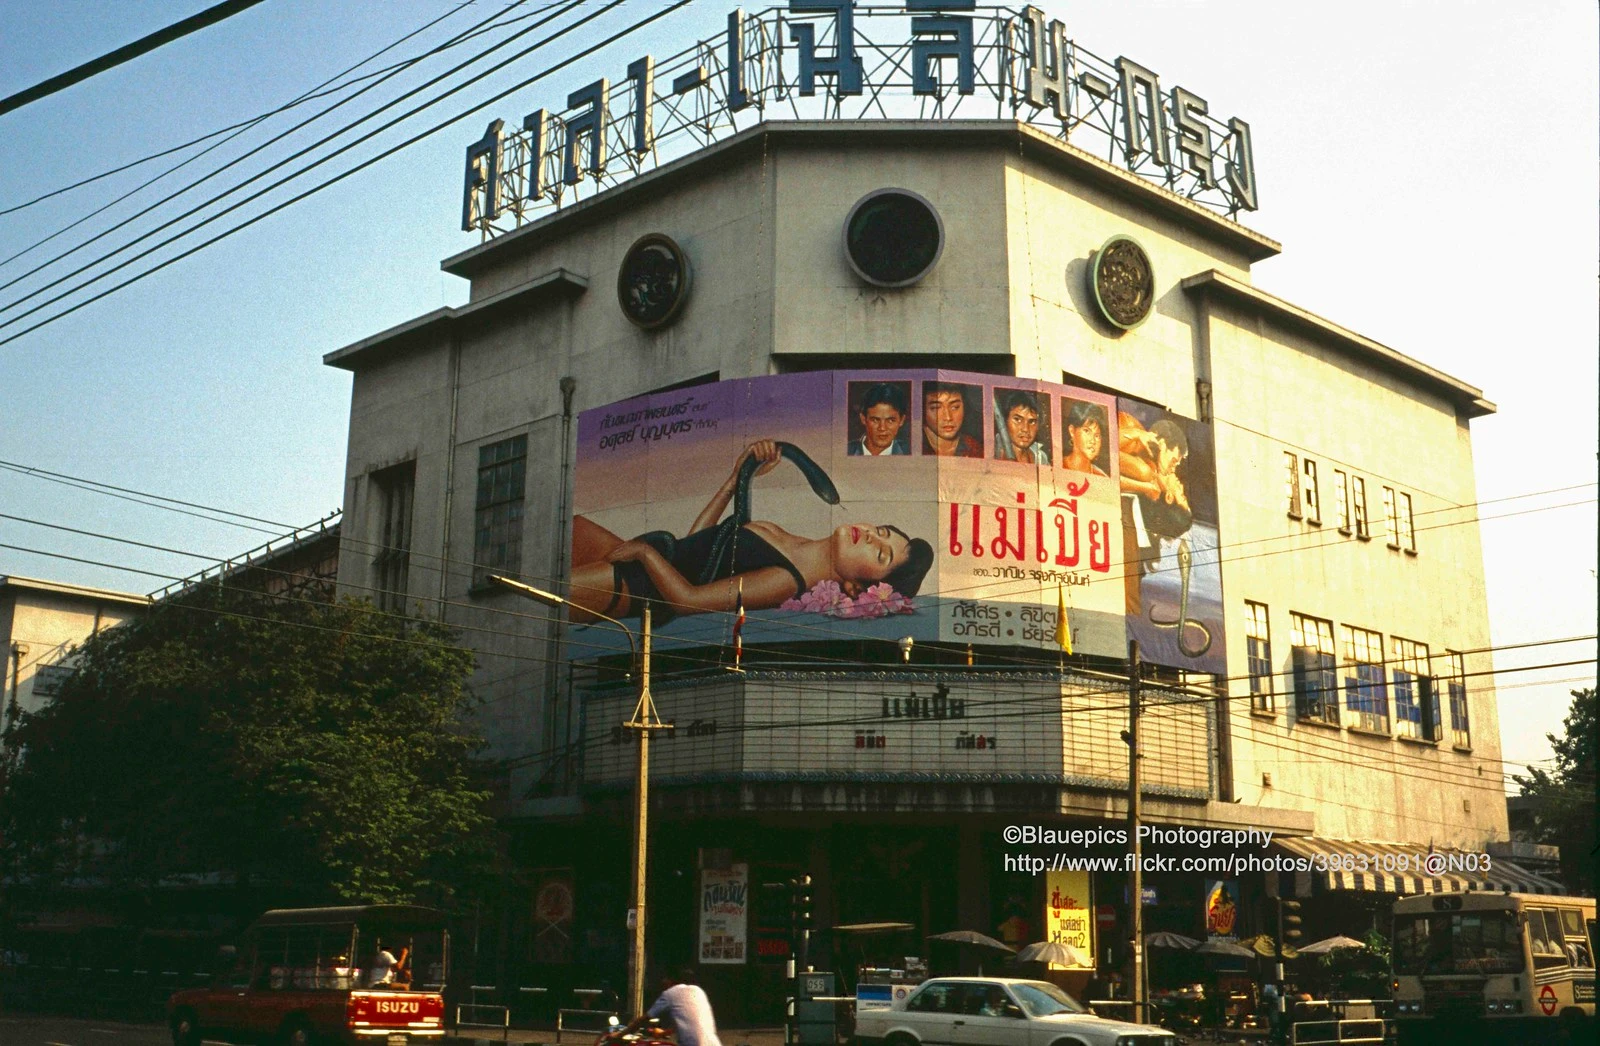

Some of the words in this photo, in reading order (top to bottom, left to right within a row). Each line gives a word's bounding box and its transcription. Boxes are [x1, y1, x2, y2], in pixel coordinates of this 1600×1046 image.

[949, 477, 1110, 573] แม่เบี้ย
[952, 600, 999, 619] ภัสสร
[1020, 606, 1056, 623] ลิขิต
[953, 621, 1001, 638] อภิรดี
[376, 1002, 419, 1014] ISUZU
